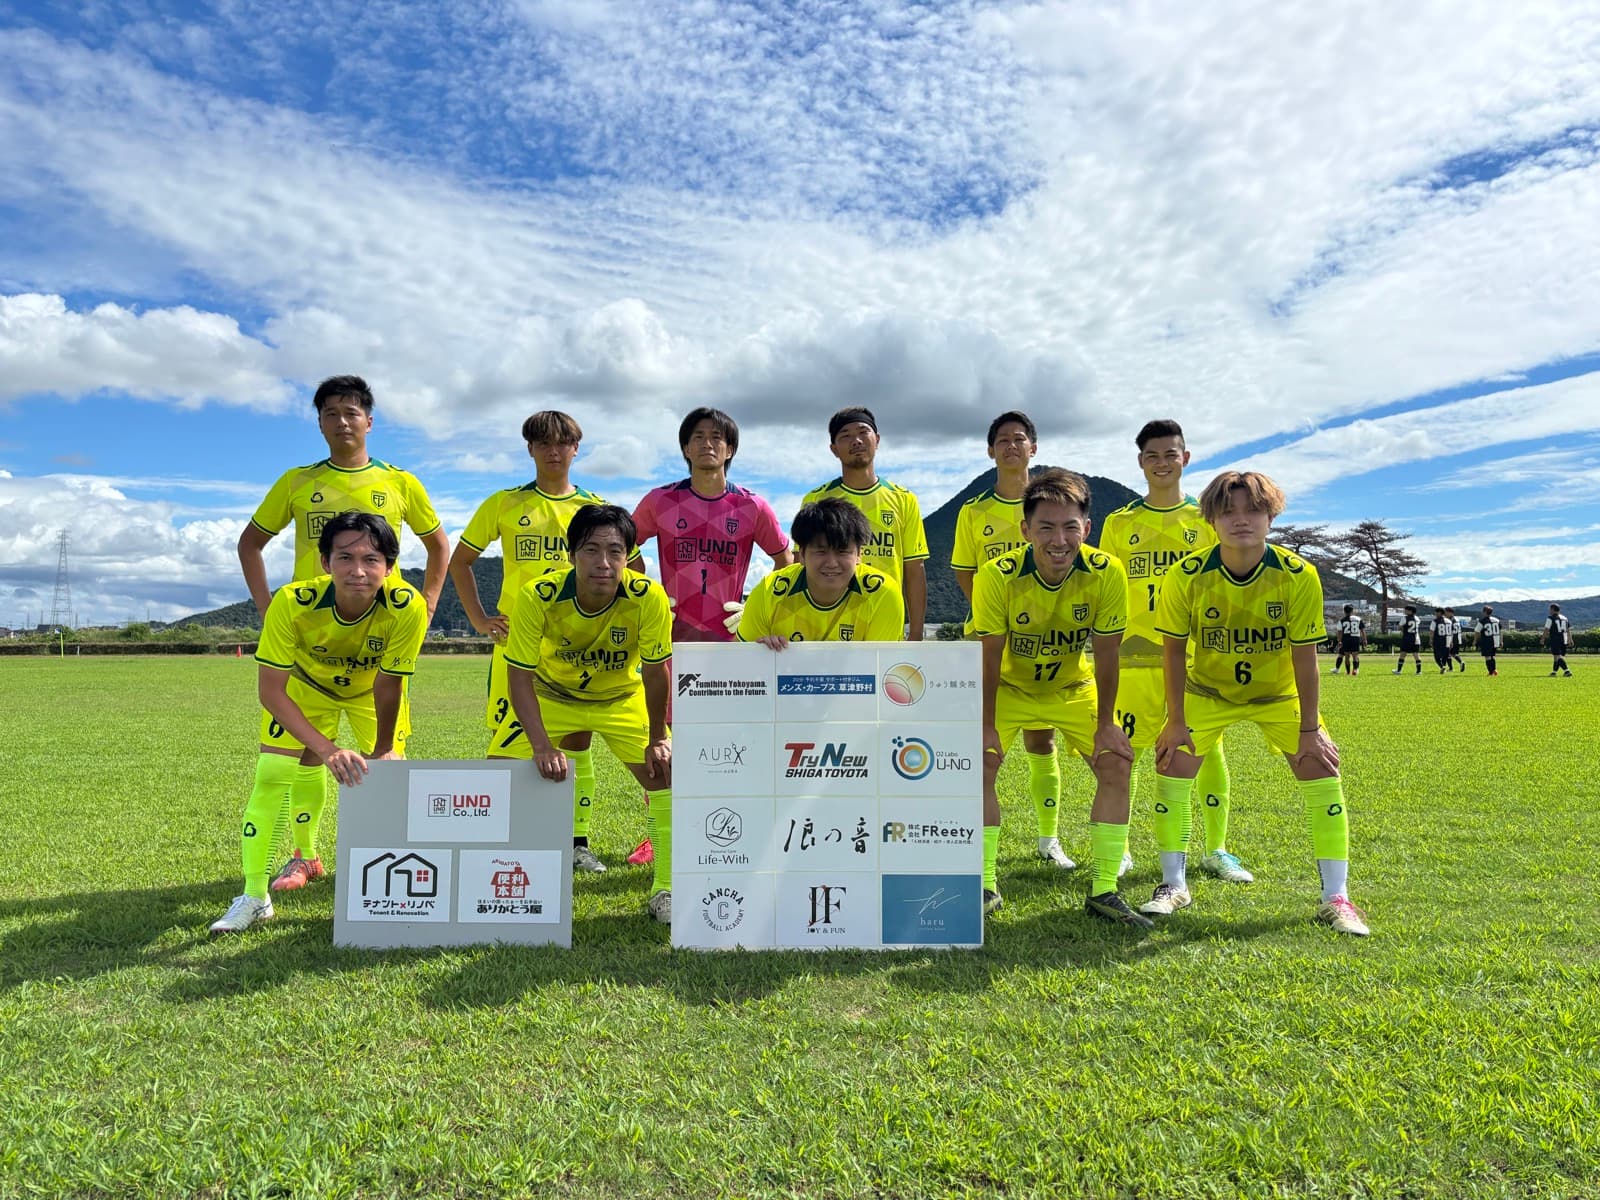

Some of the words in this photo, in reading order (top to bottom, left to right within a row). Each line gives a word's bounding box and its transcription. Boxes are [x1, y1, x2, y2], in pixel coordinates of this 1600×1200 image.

[545, 536, 571, 552] UN
[861, 532, 895, 547] ND
[1153, 551, 1193, 566] UN
[1233, 626, 1287, 644] UND
[1342, 620, 1360, 635] 28
[1484, 621, 1500, 637] 30
[1041, 628, 1091, 647] UND
[1034, 661, 1062, 682] 17
[1234, 660, 1253, 686] 6
[695, 680, 728, 688] Fumihito
[688, 689, 724, 697] Contribute
[724, 689, 732, 697] to
[732, 689, 744, 697] the
[494, 697, 509, 724] 3
[500, 720, 524, 748] 7
[936, 758, 972, 771] U-NO
[785, 768, 823, 778] SHIGA
[824, 768, 869, 778] TOYOTA
[453, 794, 491, 808] UND
[452, 808, 473, 817] Co.,
[474, 808, 491, 817] Ltd.
[922, 825, 974, 840] FReety
[698, 853, 750, 865] Life-With
[702, 887, 744, 905] CANCHA
[477, 904, 543, 914] ありがとう屋
[717, 901, 729, 920] C
[702, 909, 723, 931] FOOTBALL
[725, 908, 744, 931] ACADEMY
[920, 915, 945, 926] haru
